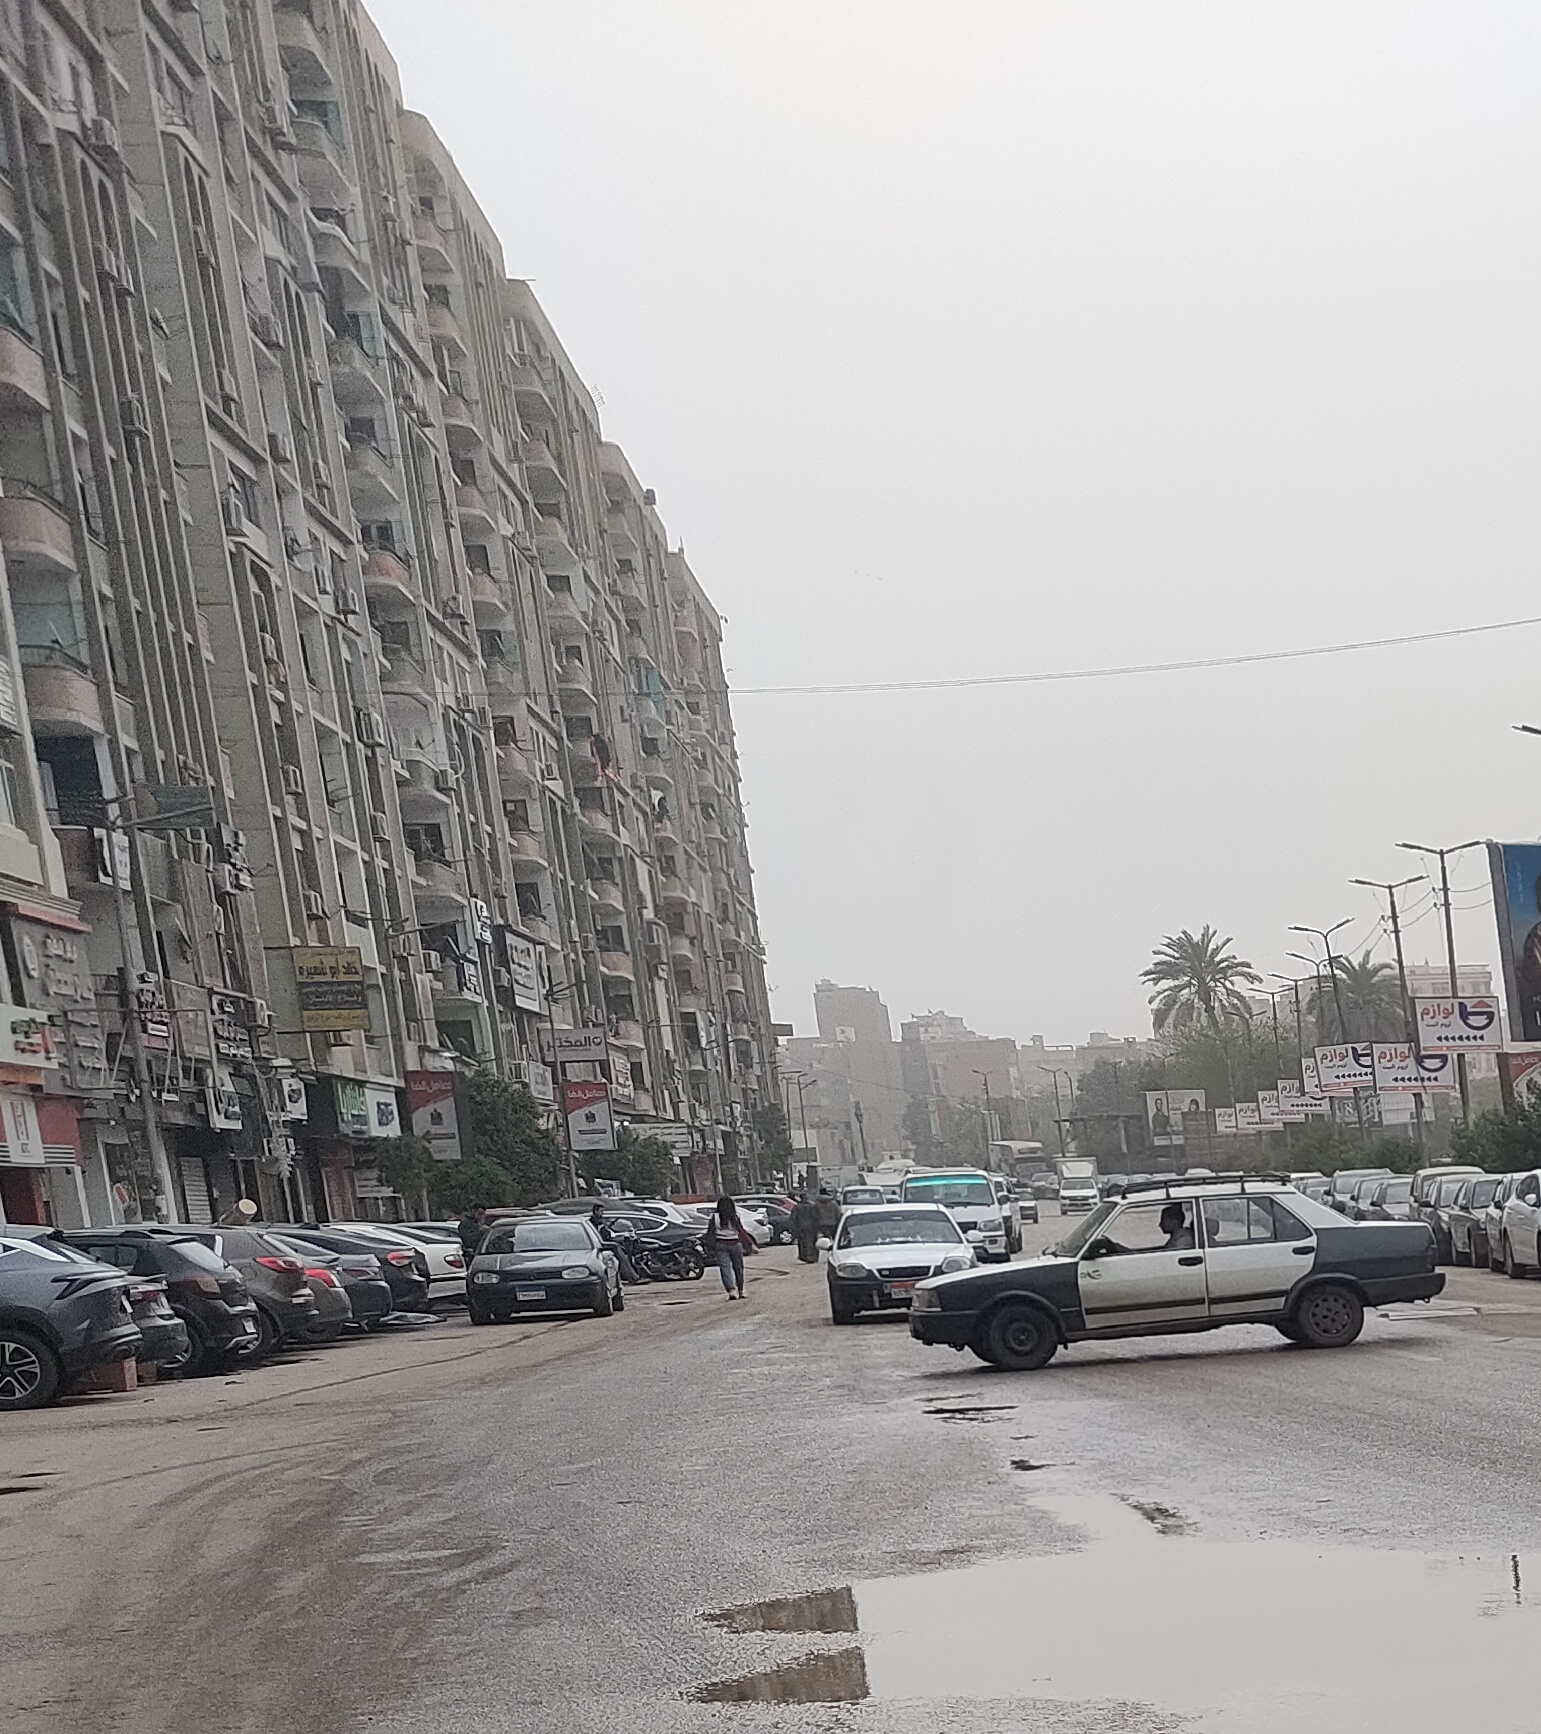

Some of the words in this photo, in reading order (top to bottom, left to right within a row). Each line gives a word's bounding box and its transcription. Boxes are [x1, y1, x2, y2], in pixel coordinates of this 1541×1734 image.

[1421, 1002, 1455, 1021] لوازم
[1320, 1047, 1348, 1064] لوازم
[1377, 1046, 1411, 1064] لوازم
[1280, 1082, 1300, 1095] وازم
